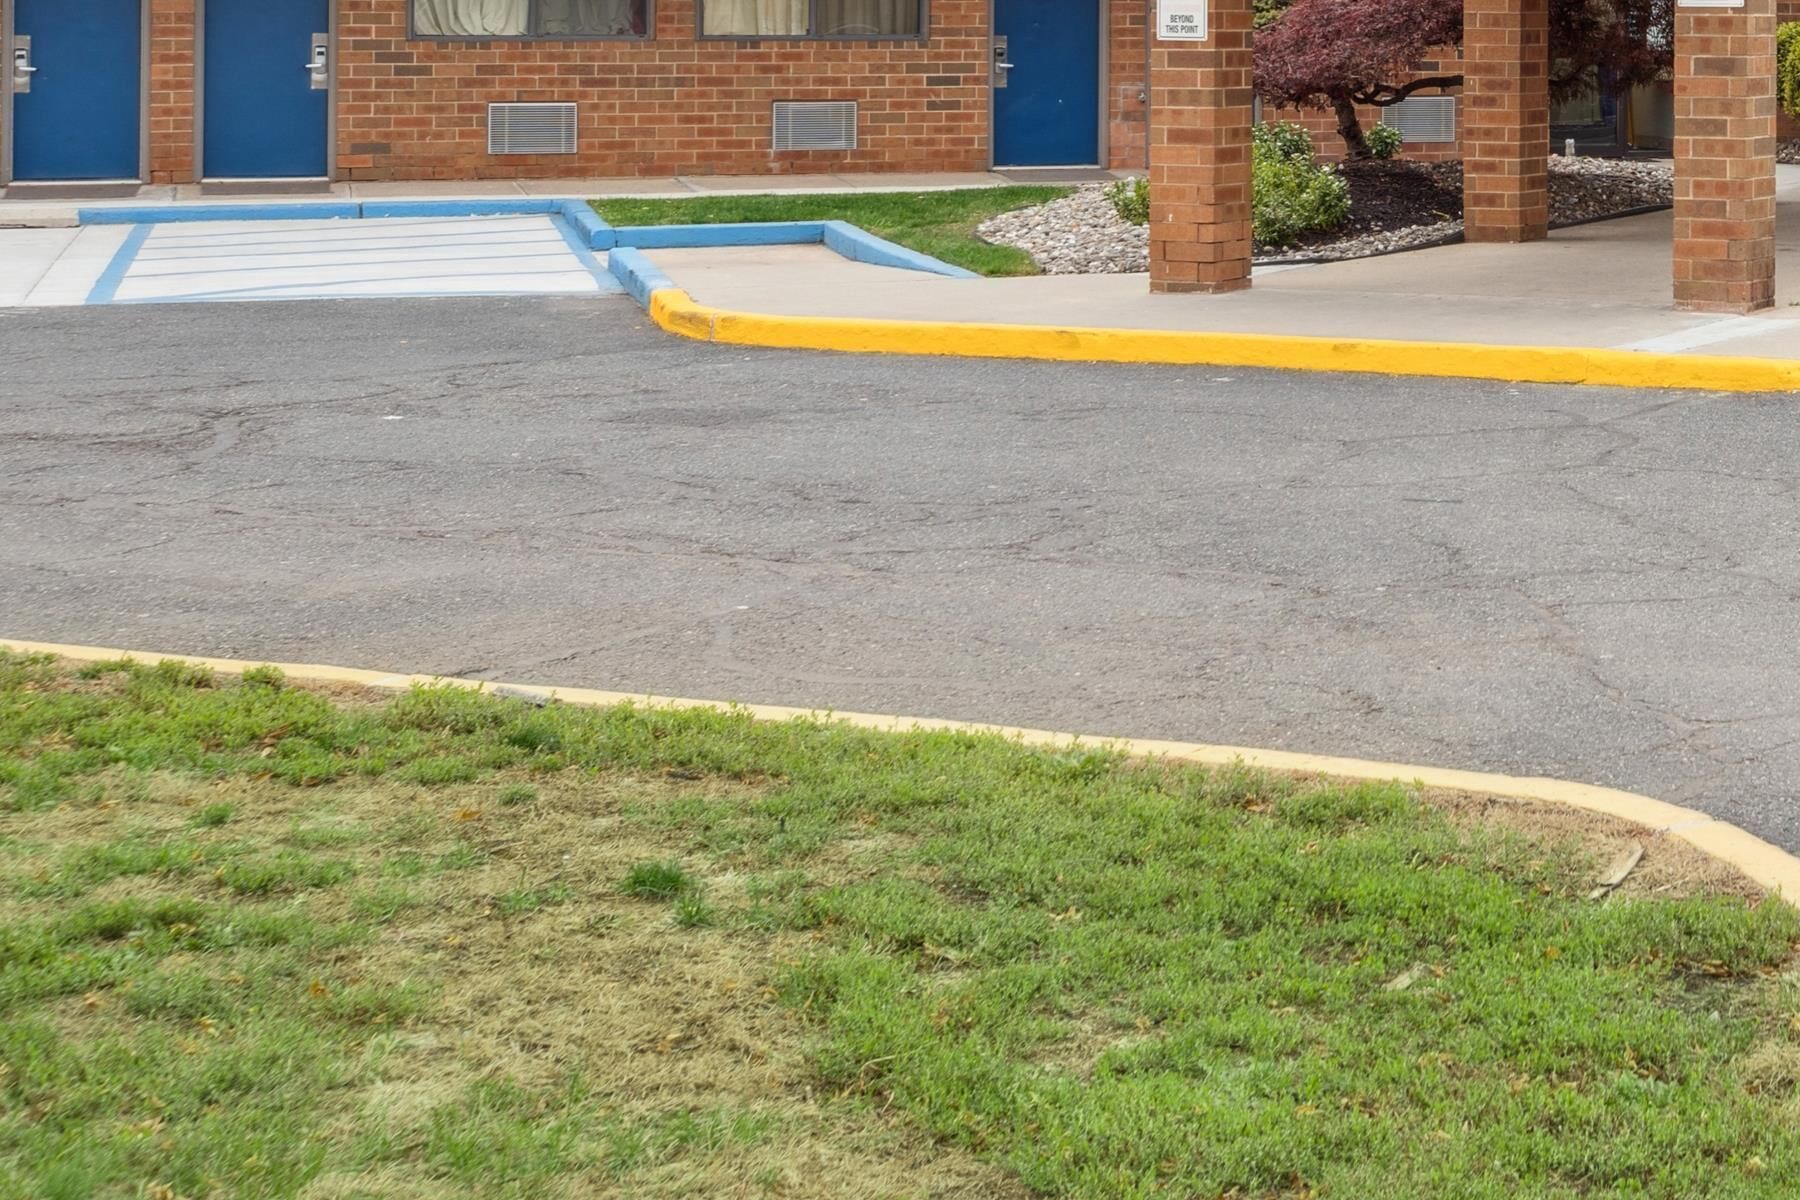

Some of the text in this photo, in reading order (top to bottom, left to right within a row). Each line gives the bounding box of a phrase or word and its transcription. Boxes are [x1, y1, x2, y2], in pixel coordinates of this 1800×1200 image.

[1170, 14, 1194, 23] BEYOND
[1165, 25, 1198, 33] THIS POINT
